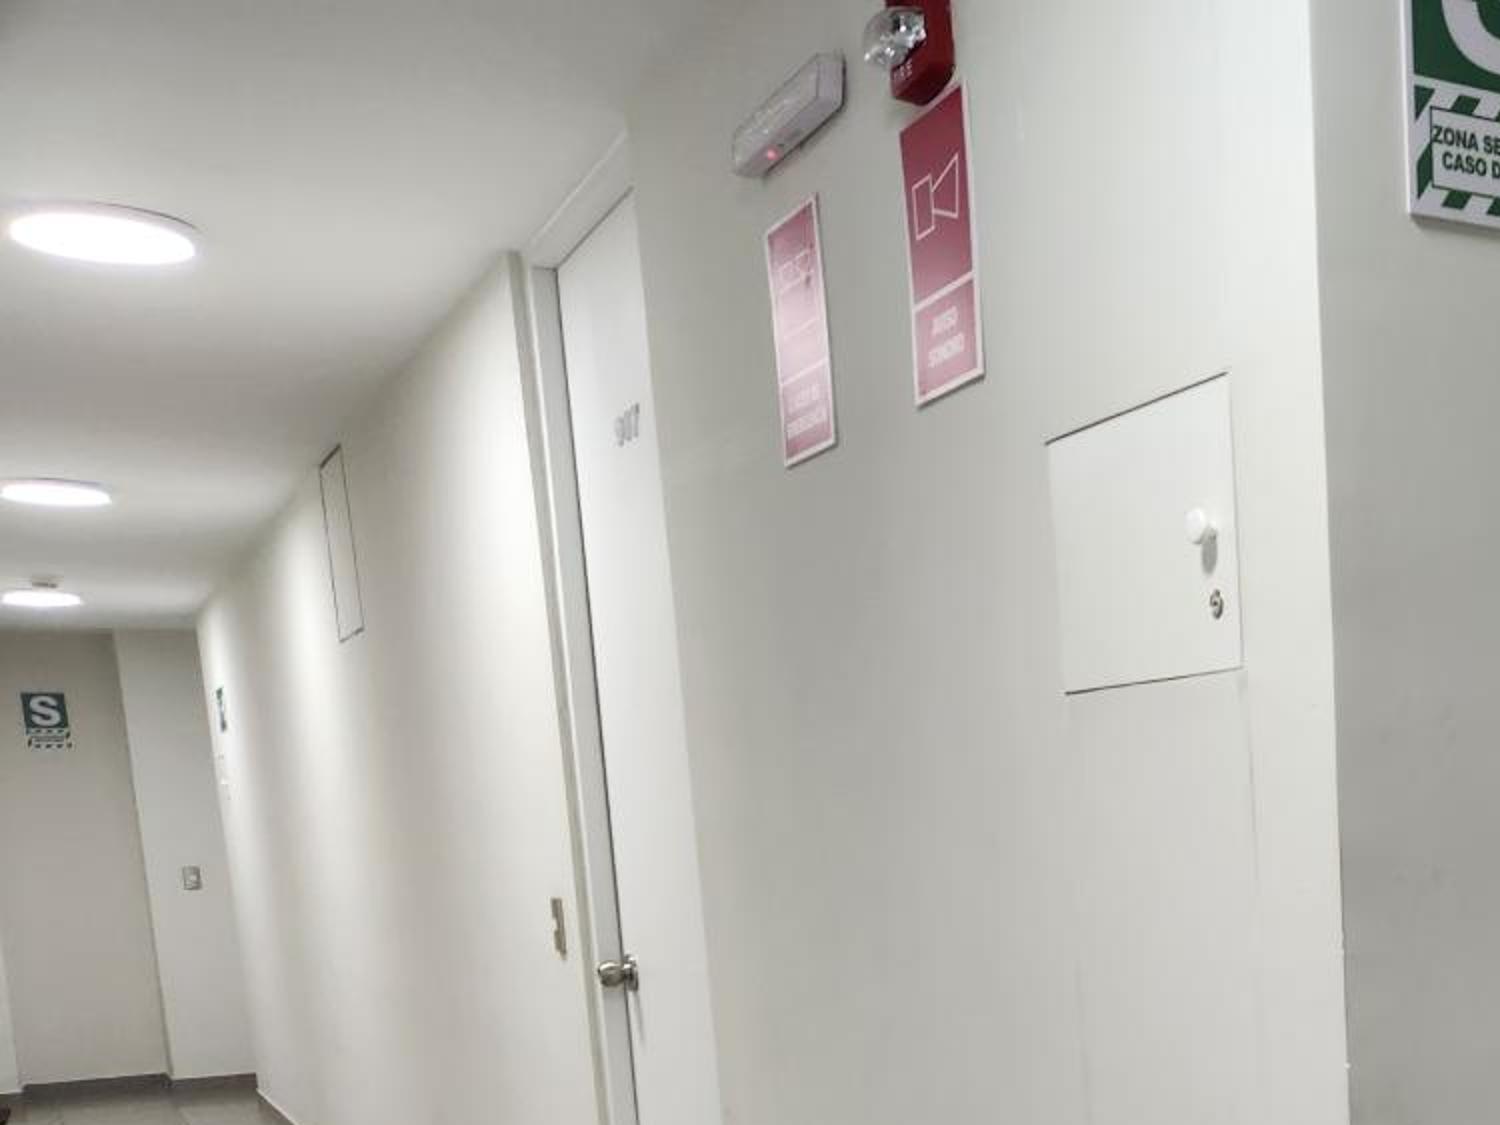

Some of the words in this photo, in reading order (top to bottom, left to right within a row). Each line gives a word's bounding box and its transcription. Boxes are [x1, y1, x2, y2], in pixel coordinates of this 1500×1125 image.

[1431, 125, 1479, 151] ZONA
[1441, 151, 1487, 177] CASO
[28, 695, 62, 727] S
